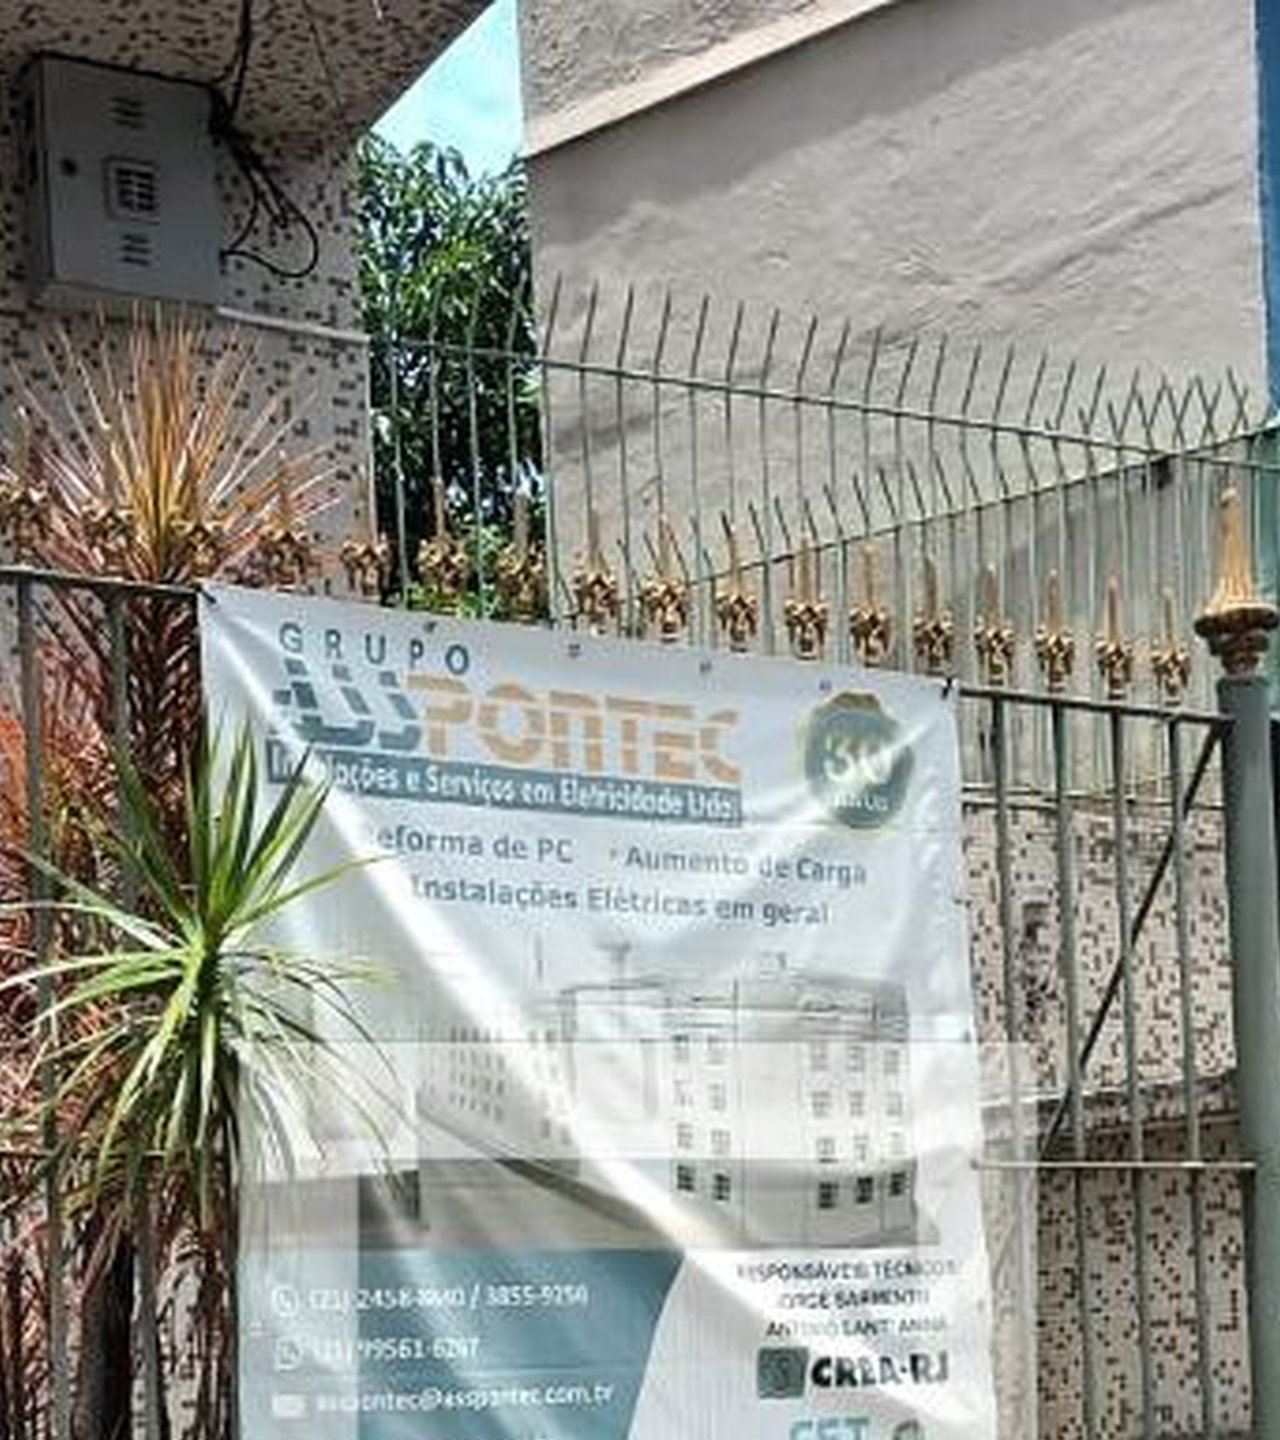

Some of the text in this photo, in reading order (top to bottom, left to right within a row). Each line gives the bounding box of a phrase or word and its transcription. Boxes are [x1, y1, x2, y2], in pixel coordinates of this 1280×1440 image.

[279, 621, 470, 676] GRUPO
[425, 765, 516, 804] Serviços
[521, 782, 556, 804] em
[560, 777, 682, 816] Eletricidade
[371, 823, 484, 857] eforma
[492, 834, 528, 860] de
[536, 836, 573, 864] PC
[625, 846, 749, 876] Aumento
[796, 857, 867, 889] Carga
[586, 886, 707, 917] Elétricas
[715, 900, 754, 920] em
[762, 902, 828, 928] geral
